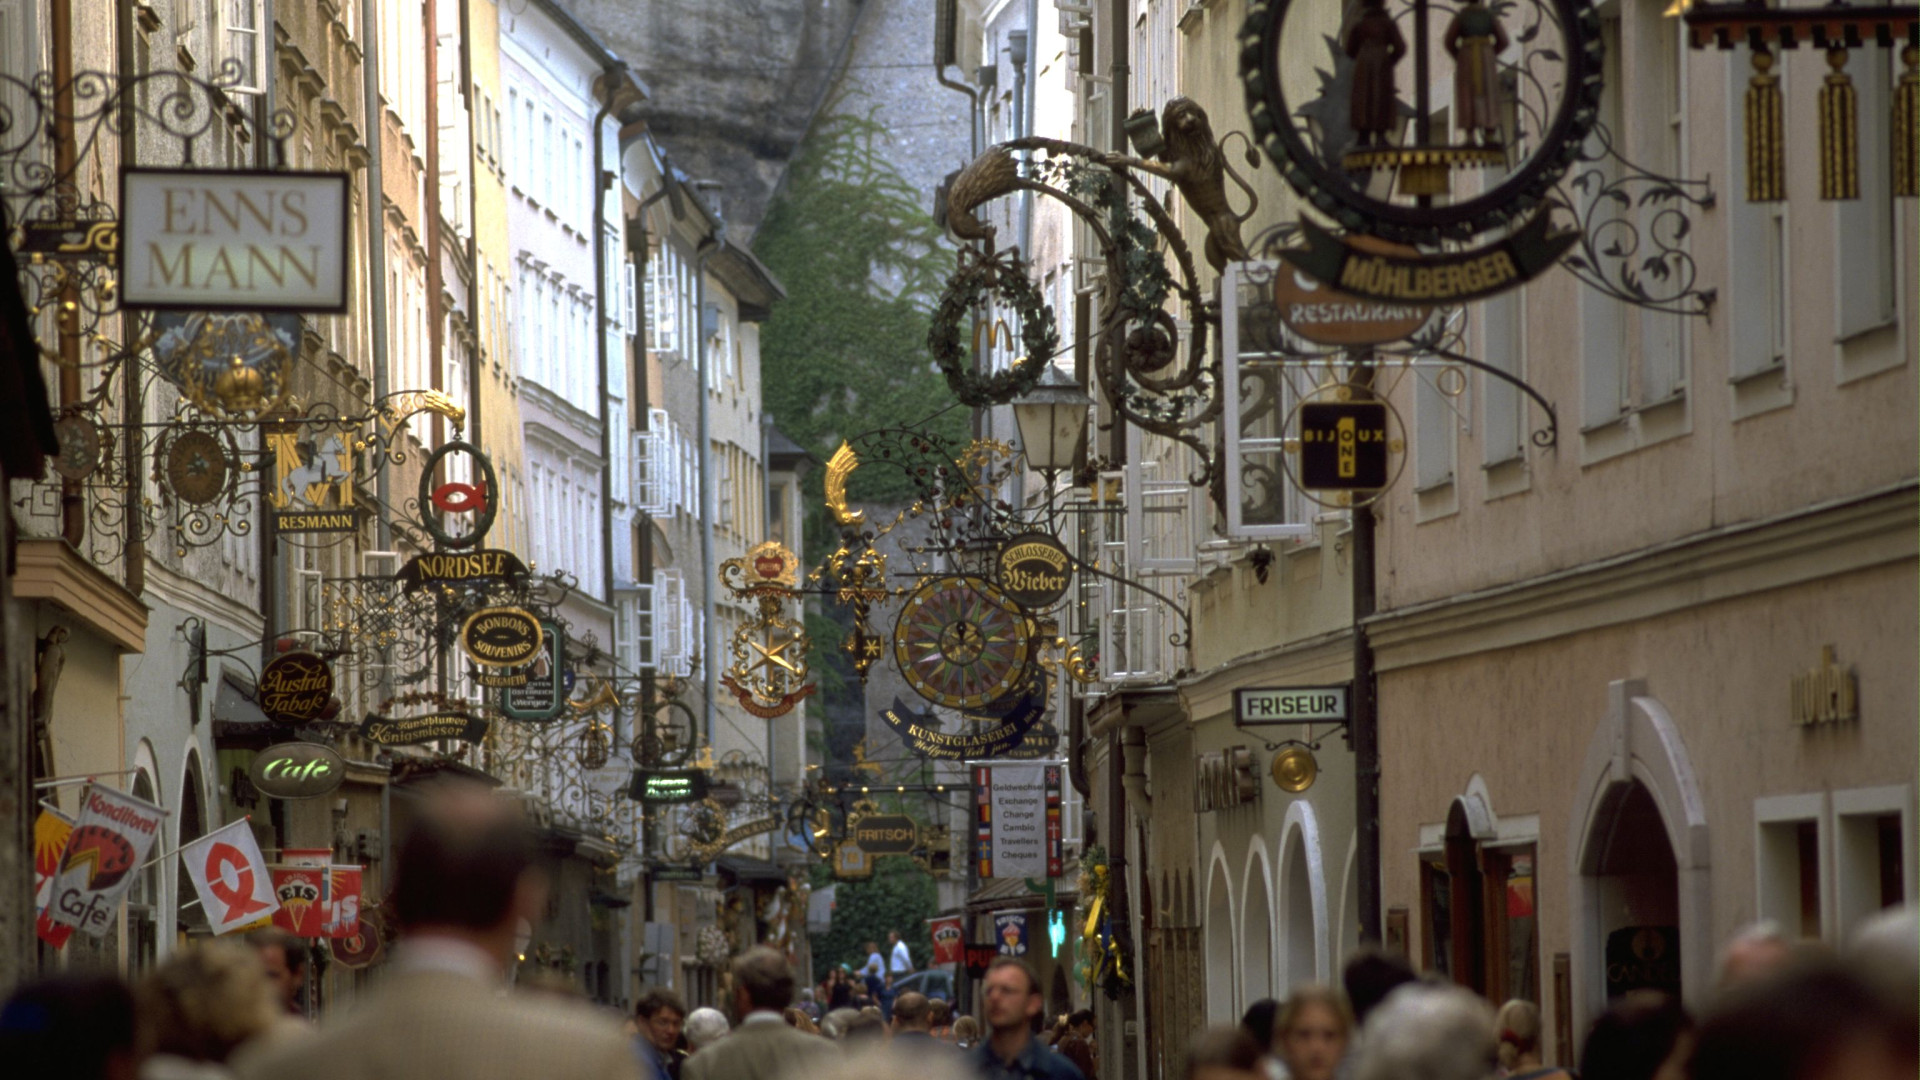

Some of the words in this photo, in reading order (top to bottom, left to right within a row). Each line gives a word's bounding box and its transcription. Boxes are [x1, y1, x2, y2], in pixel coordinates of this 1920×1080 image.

[162, 187, 309, 238] ENNS
[147, 240, 323, 290] MANN
[1340, 250, 1517, 298] MÜHLBERGER
[1303, 428, 1384, 443] BIJOUX
[278, 514, 353, 529] RESMANN
[1004, 545, 1063, 565] SCHLOSSEREI
[418, 552, 507, 580] NORDSEE
[1001, 568, 1066, 593] Wieber
[476, 617, 531, 636] BONBONS
[474, 640, 532, 658] SOUVENIRS
[261, 663, 329, 692] Austria
[263, 690, 328, 714] Tabak
[1247, 695, 1337, 716] FRISEUR
[885, 710, 902, 725] SEIT
[908, 722, 1018, 747] KUNSTGLASEREI
[262, 757, 332, 782] Café
[992, 783, 1044, 792] Geldwechsel
[998, 797, 1039, 806] Exchange
[86, 791, 159, 837] Konditorei
[1003, 811, 1034, 820] Change
[858, 829, 913, 841] FRITSCH
[1003, 824, 1036, 832] Cambio
[1000, 837, 1039, 846] Travellers
[1001, 851, 1038, 860] Cheques
[278, 885, 317, 902] EIS
[59, 886, 111, 928] Café
